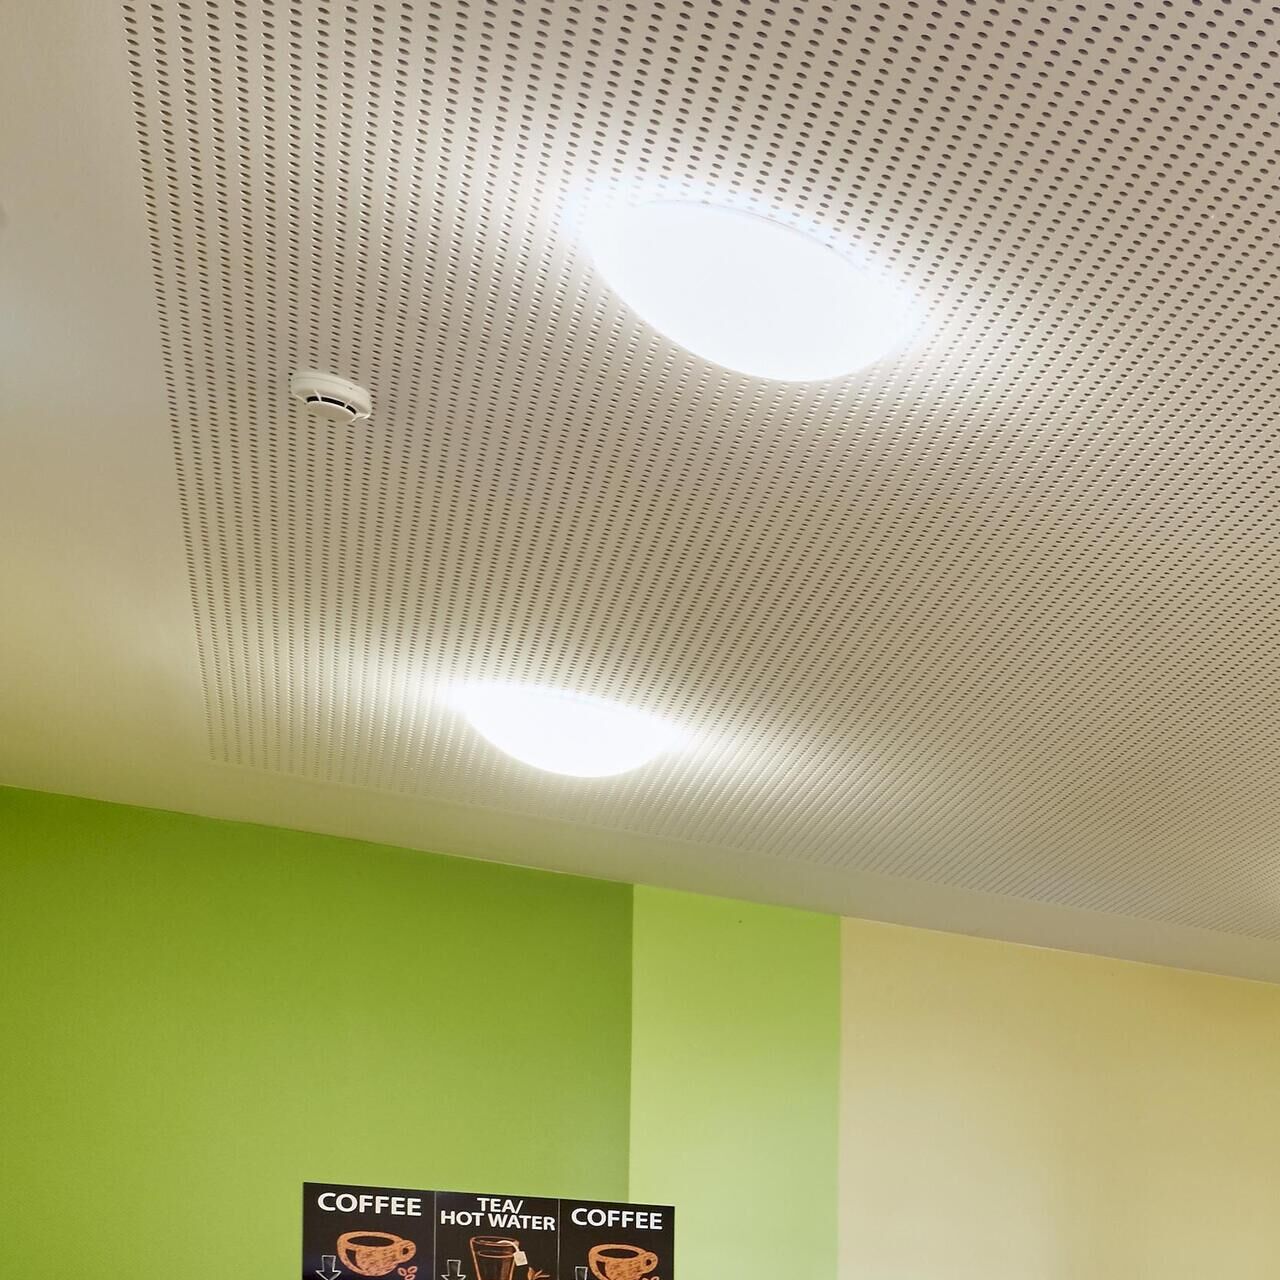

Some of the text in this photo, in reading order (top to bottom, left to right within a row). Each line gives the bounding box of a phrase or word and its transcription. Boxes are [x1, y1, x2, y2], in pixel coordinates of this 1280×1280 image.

[317, 1191, 422, 1217] COFFEE
[476, 1197, 524, 1214] TEA/
[440, 1210, 556, 1231] HOT WATER
[571, 1207, 663, 1231] COFFEE
